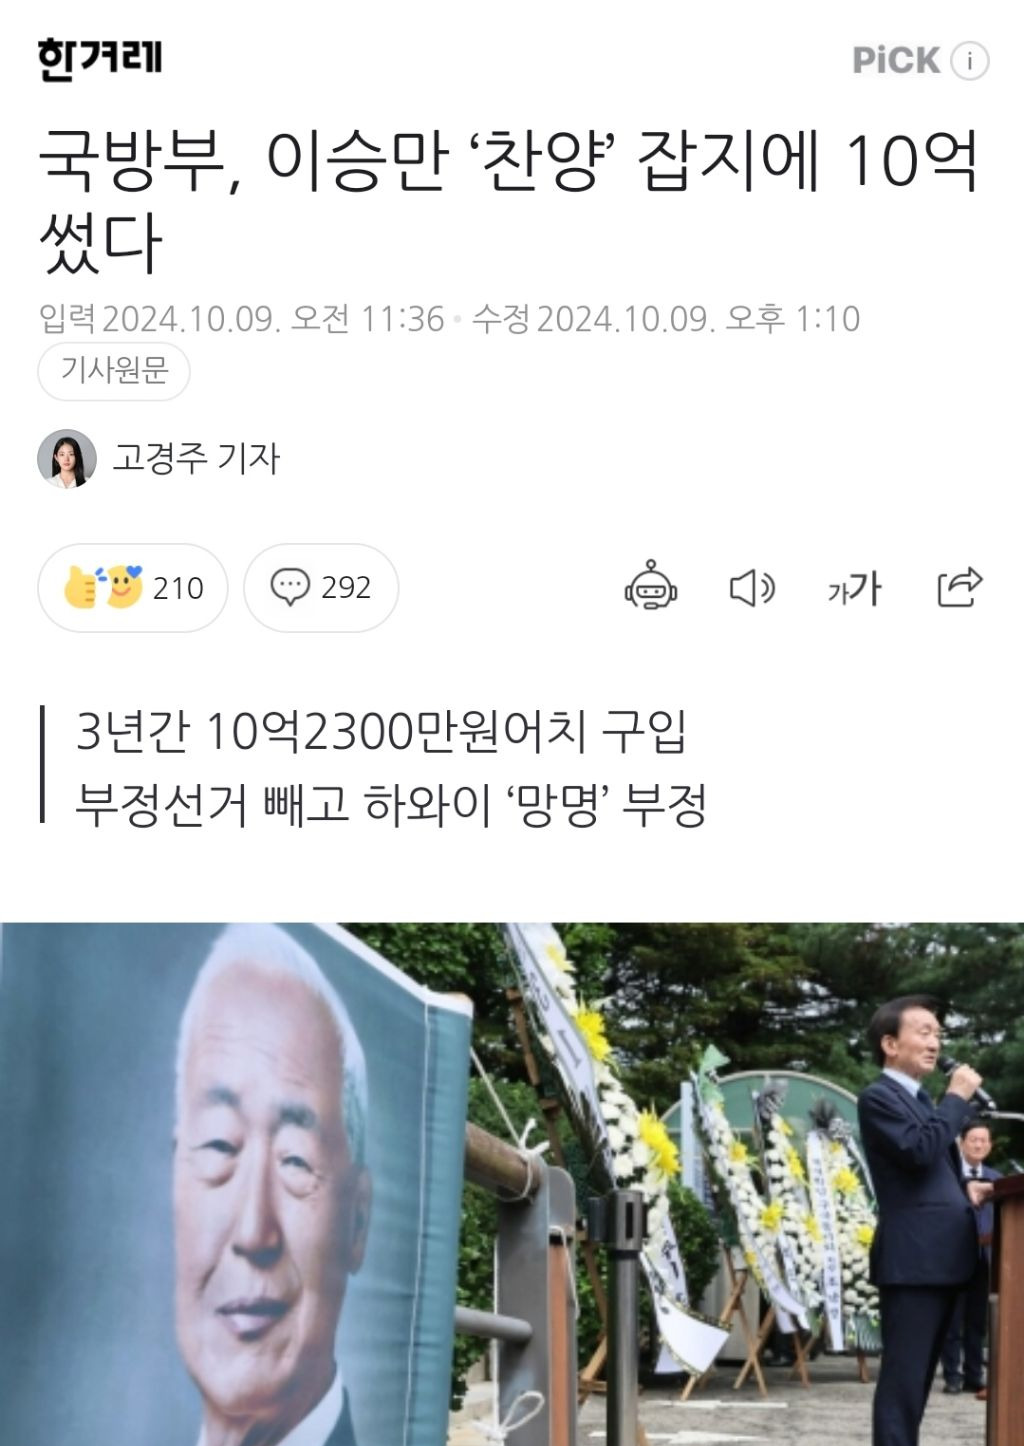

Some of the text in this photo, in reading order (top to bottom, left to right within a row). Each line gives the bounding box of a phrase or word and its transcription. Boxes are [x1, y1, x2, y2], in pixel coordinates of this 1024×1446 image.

[37, 36, 163, 84] 한겨레
[38, 128, 240, 196] 국방부,
[267, 128, 450, 194] 이승만
[638, 128, 817, 193] 잡지에
[848, 128, 975, 193] 10억
[39, 211, 164, 276] 썼다
[290, 303, 349, 334] 오전
[363, 304, 445, 332] 11:36
[471, 303, 529, 335] 수정
[725, 303, 786, 335] 오후
[797, 304, 860, 332] 1:10
[61, 355, 169, 385] 기사원문
[112, 441, 281, 476] 고경주 기자
[153, 576, 204, 600] 210
[321, 575, 371, 599] 292
[77, 709, 685, 755] 3년간 10억2300만원어치 구입
[75, 783, 245, 829] 부정선거
[264, 783, 350, 829] 빼고
[363, 783, 489, 829] 하와이
[621, 783, 705, 829] 부정
